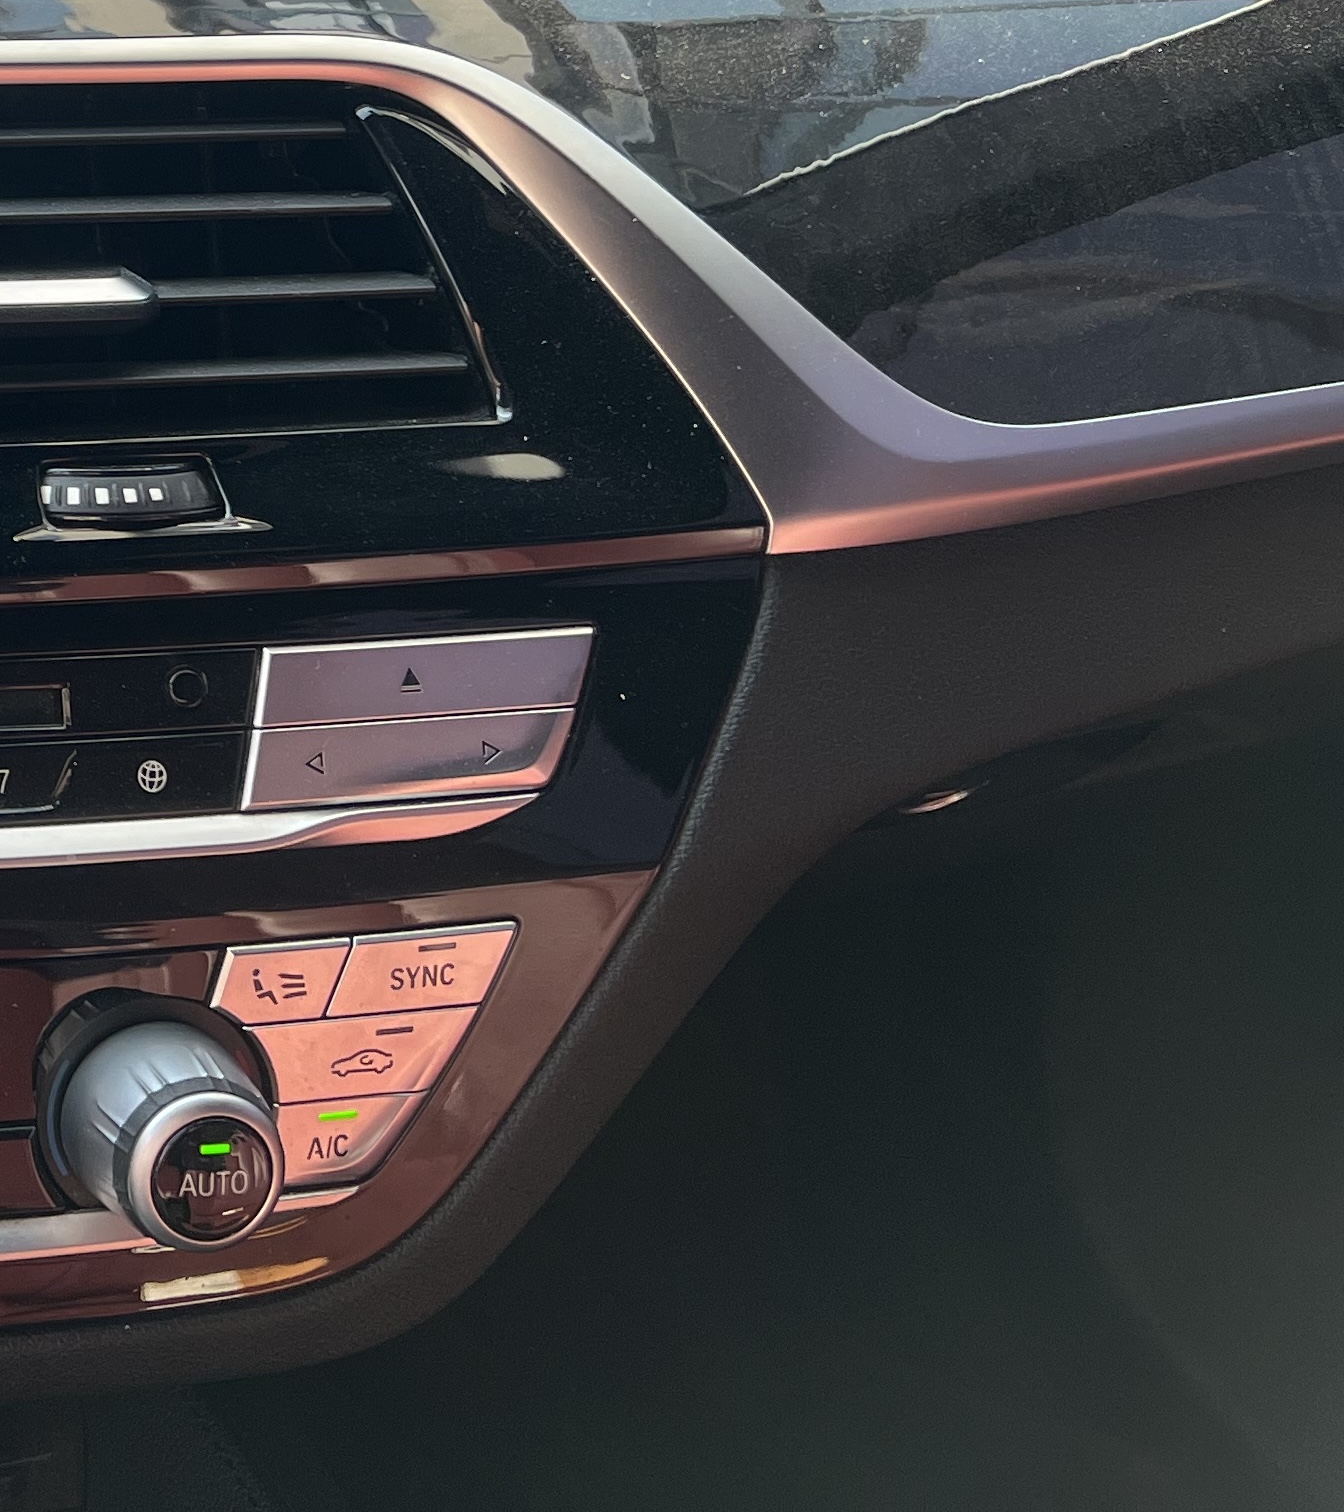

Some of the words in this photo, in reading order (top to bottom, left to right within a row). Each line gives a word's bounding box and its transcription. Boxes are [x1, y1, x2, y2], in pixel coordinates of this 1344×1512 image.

[389, 963, 456, 992] SYNC
[306, 1134, 350, 1161] A/C
[179, 1169, 248, 1199] AUTO
